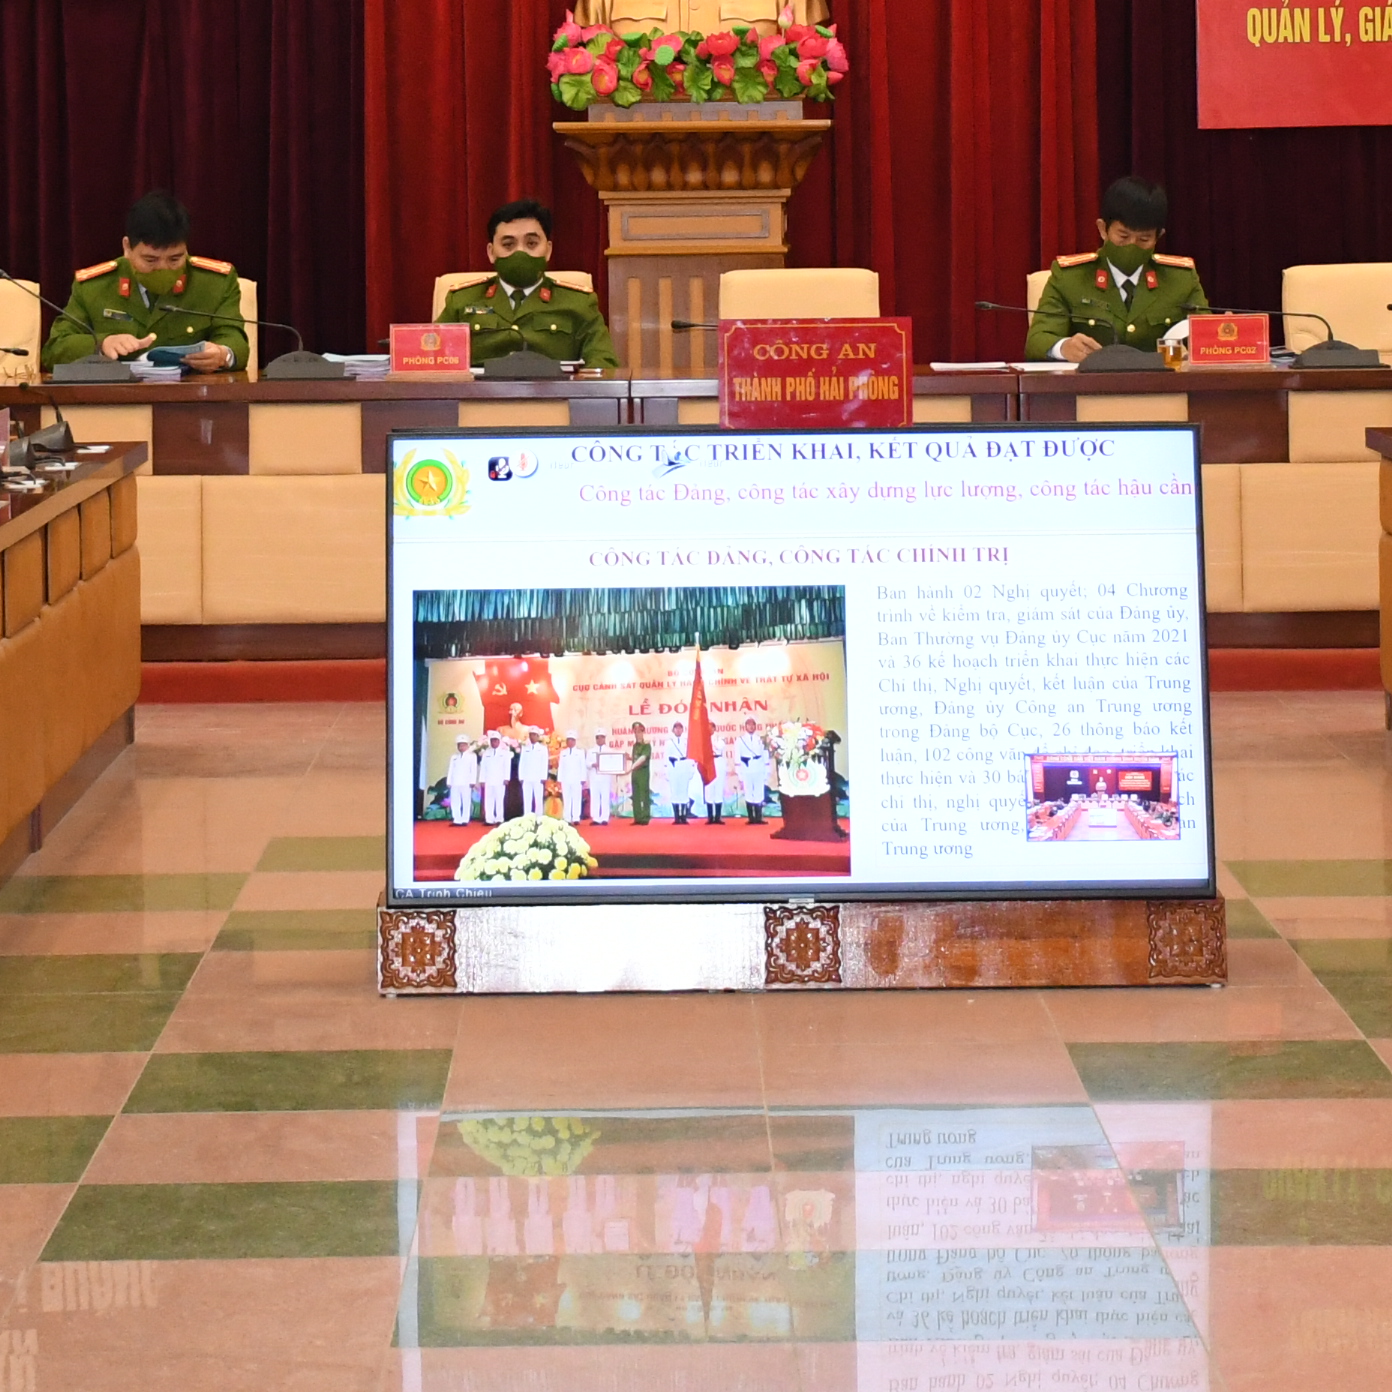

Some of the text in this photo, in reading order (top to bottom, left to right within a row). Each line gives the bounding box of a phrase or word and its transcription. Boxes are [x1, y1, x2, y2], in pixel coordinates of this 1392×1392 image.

[1318, 0, 1351, 46] LÝ,
[402, 354, 460, 365] PHÒNG PC06
[753, 340, 876, 360] CÔNG AN
[1200, 345, 1257, 355] PHÒNG PC02
[733, 366, 898, 401] THÀNH PHỐ HẢI PHÒNG
[572, 440, 642, 463] CÔNG
[869, 437, 917, 459] KẾT
[925, 436, 977, 463] QUẢ
[986, 441, 1035, 462] ĐẠT
[1043, 438, 1115, 461] ĐƯỢC
[580, 485, 631, 506] Công
[639, 485, 664, 500] tác
[738, 484, 784, 504] công
[793, 483, 818, 498] tác
[827, 483, 859, 503] xây
[868, 481, 916, 503] dựng
[925, 481, 952, 497] lực
[962, 480, 1022, 502] lượng,
[1030, 481, 1076, 501] công
[1084, 479, 1109, 495] tác
[1119, 478, 1151, 495] hậu
[1160, 474, 1191, 494] cần
